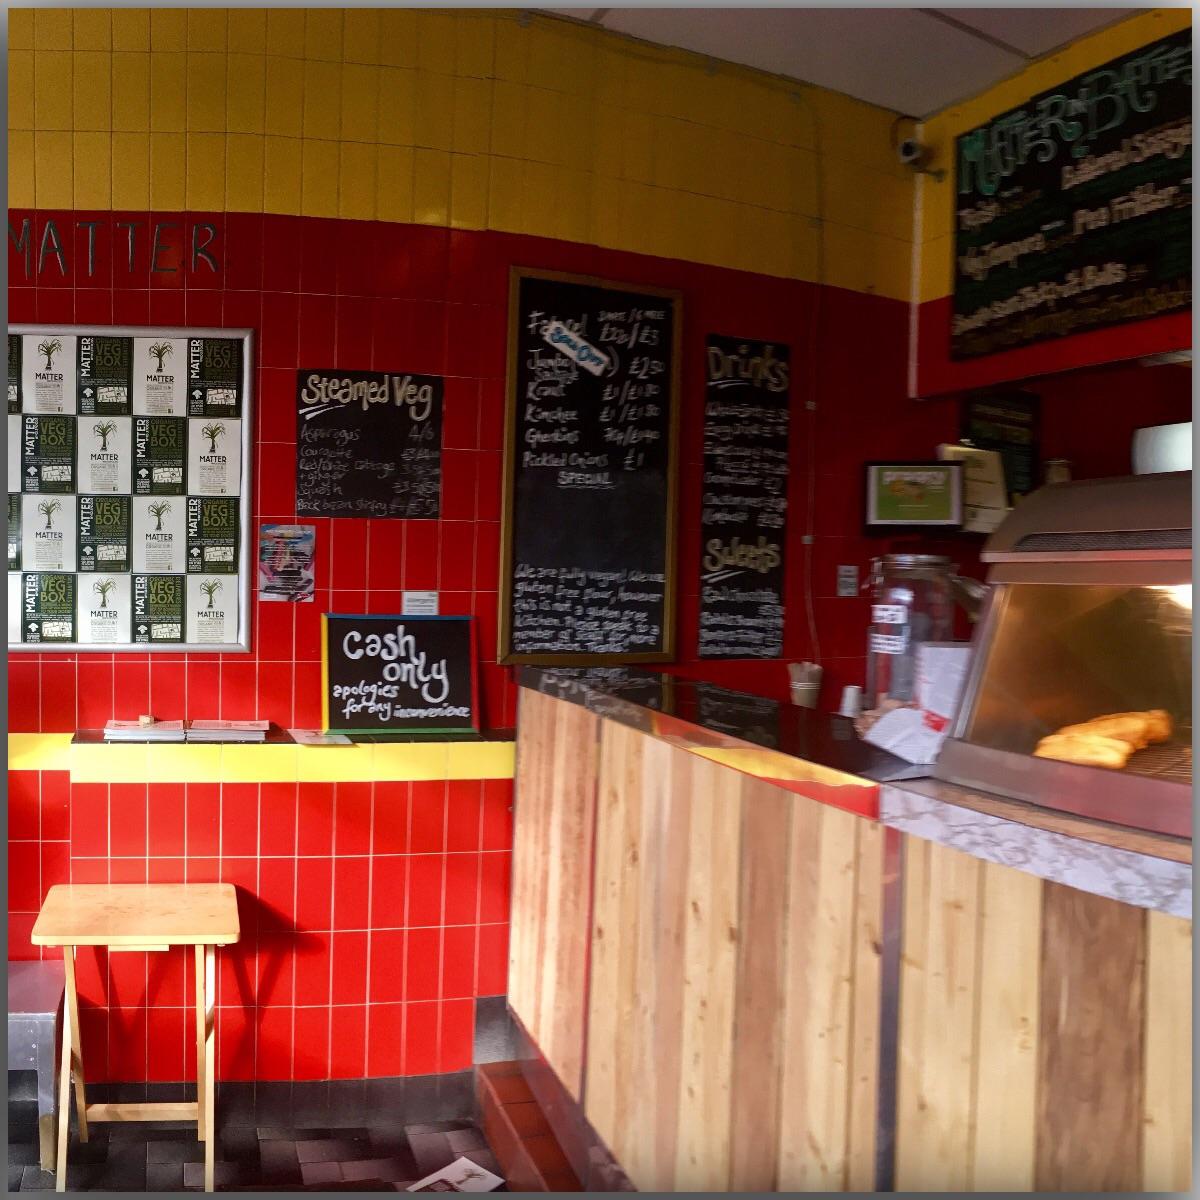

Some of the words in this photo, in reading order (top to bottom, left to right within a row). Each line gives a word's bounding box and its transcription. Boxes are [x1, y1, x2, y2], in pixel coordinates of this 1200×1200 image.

[8, 218, 219, 280] MATTER
[95, 343, 121, 355] VEG
[81, 337, 91, 377] MATTER
[95, 355, 121, 366] BOX
[191, 339, 201, 379] MATTER
[707, 344, 789, 393] Drinks
[35, 372, 63, 381] MATTER
[146, 374, 174, 383] MATTER
[301, 374, 389, 411] Steamed
[392, 375, 433, 421] Veg
[40, 422, 66, 434] VEG
[151, 424, 176, 436] VEG
[25, 417, 37, 456] MATTER
[40, 434, 66, 446] BOX
[136, 419, 146, 458] MATTER
[151, 436, 176, 447] BOX
[90, 453, 118, 461] MATTER
[200, 455, 227, 463] MATTER
[95, 502, 121, 515] VEG
[203, 504, 228, 516] VEG
[81, 497, 91, 536] MATTER
[95, 514, 121, 526] BOX
[188, 498, 199, 537] MATTER
[203, 516, 228, 527] BOX
[35, 531, 63, 540] MATTER
[145, 533, 173, 541] MATTER
[41, 580, 66, 592] VEG
[150, 582, 175, 594] VEG
[26, 574, 37, 613] MATTER
[41, 592, 66, 602] BOX
[135, 576, 145, 615] MATTER
[150, 593, 174, 604] BOX
[90, 610, 118, 618] MATTER
[197, 611, 225, 619] MATTER
[343, 625, 420, 663] Cash
[382, 651, 450, 704] only
[332, 680, 400, 706] apologies
[342, 698, 365, 720] for
[367, 702, 392, 721] any
[393, 702, 471, 718] inconvenience
